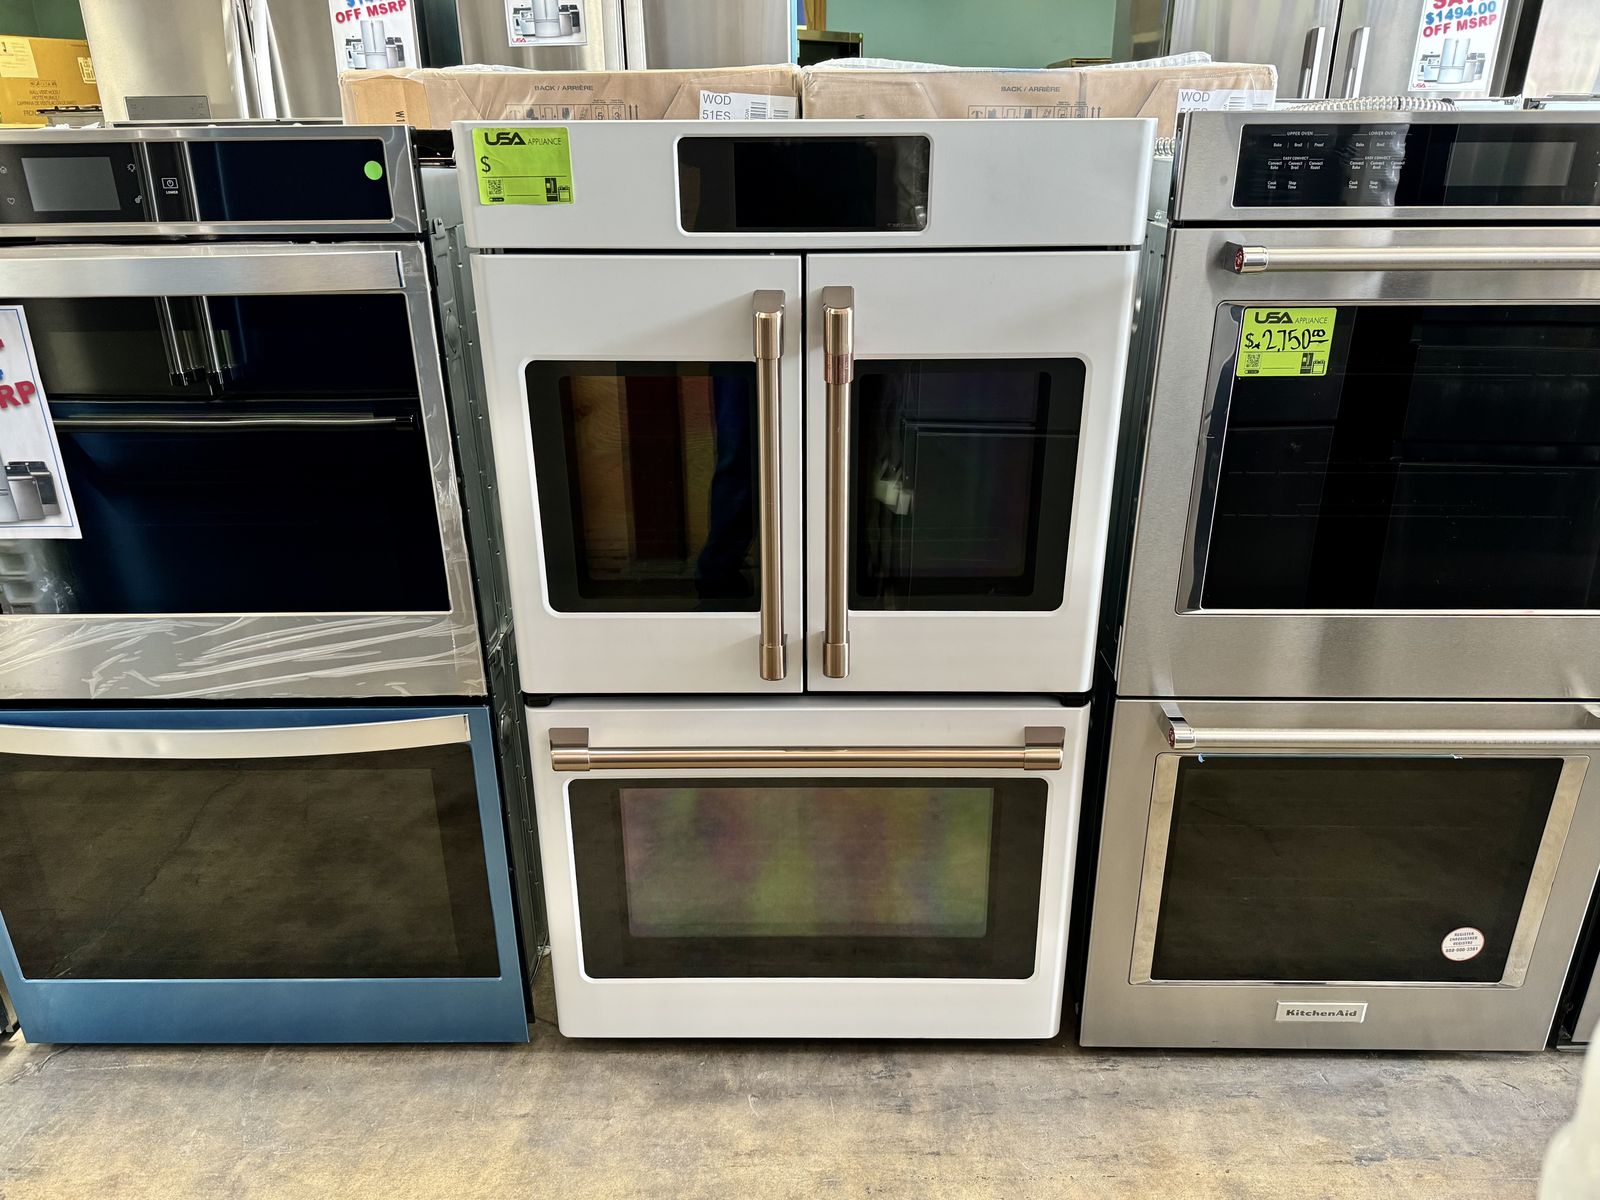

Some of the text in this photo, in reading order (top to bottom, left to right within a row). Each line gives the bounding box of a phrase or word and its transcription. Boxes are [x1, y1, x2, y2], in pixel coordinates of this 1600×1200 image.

[335, 8, 361, 24] OFF
[366, 0, 407, 17] MSRP
[1425, 1, 1496, 25] $1494.00
[1423, 14, 1497, 37] OFF MSRP
[702, 93, 732, 105] WOD
[1181, 92, 1210, 102] WOD
[702, 110, 731, 120] 51ES
[484, 132, 562, 146] USA APPLIANCE
[480, 154, 491, 174] $
[1254, 311, 1293, 324] USA
[1286, 1009, 1358, 1017] KitchenAid
